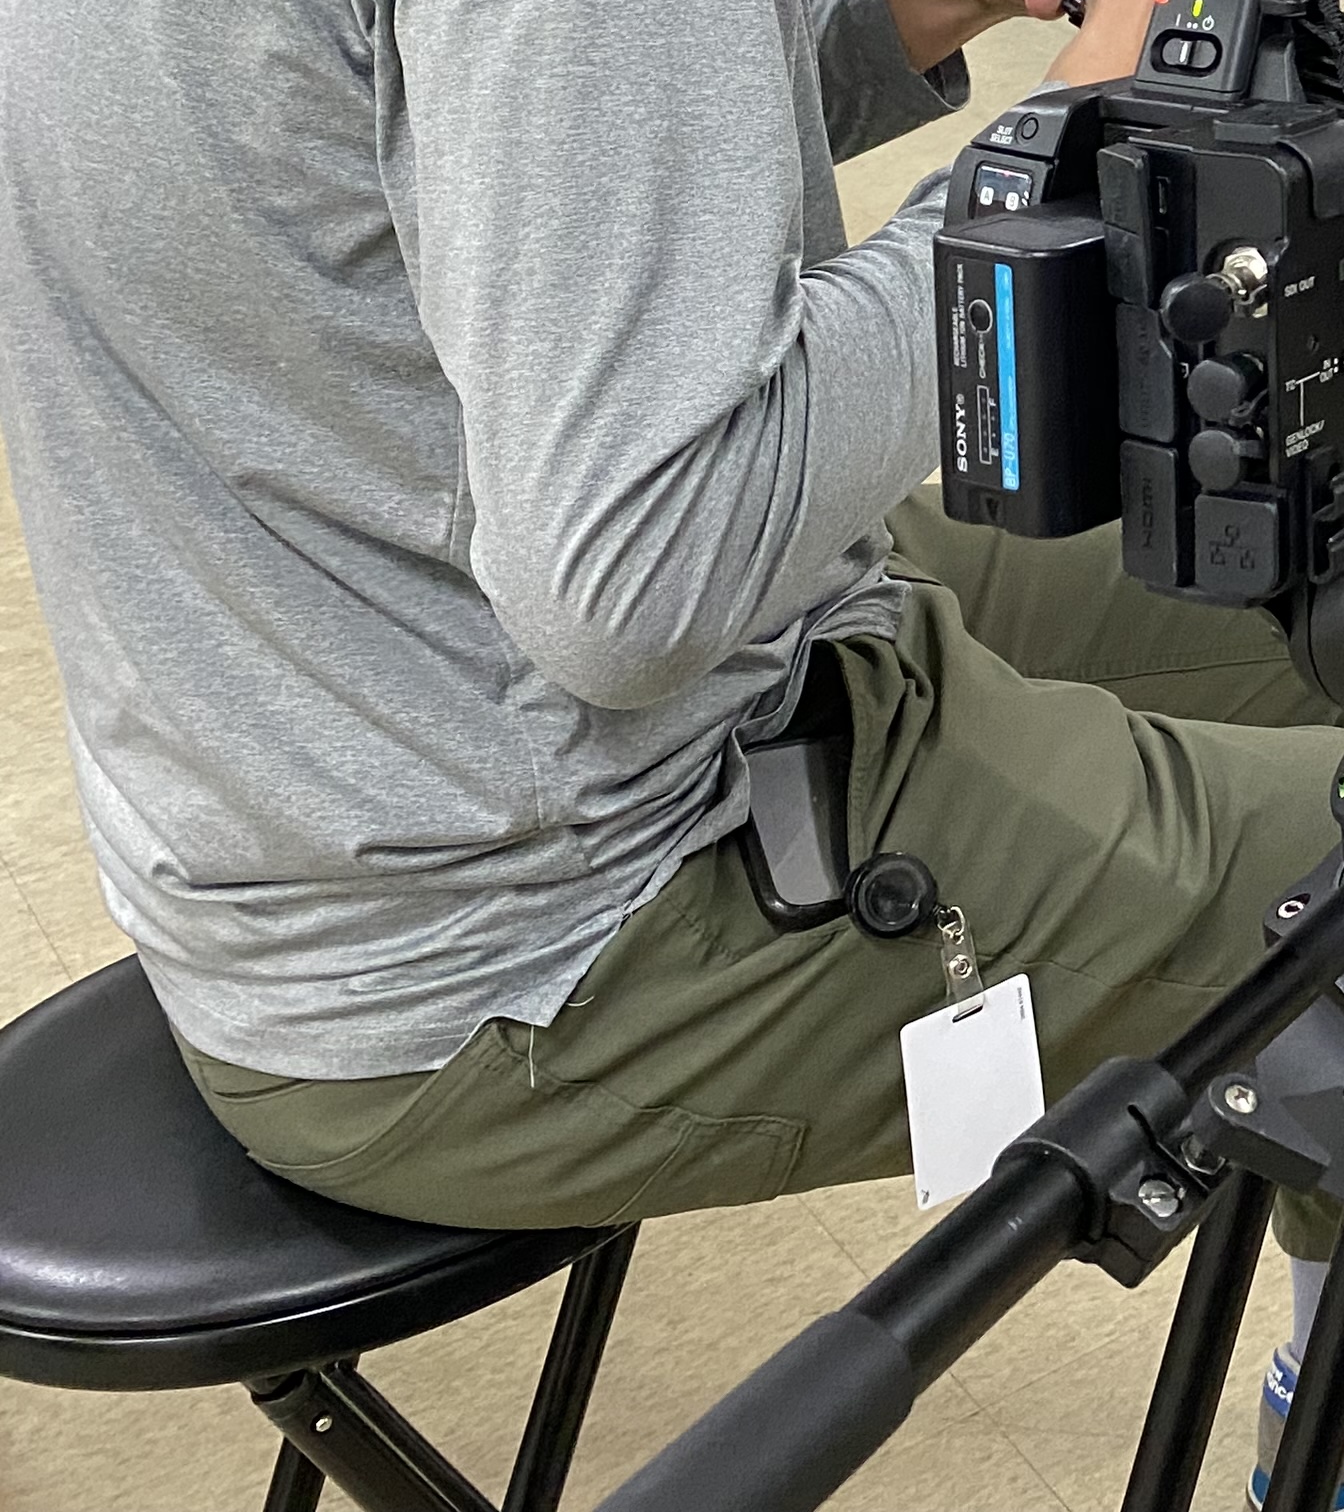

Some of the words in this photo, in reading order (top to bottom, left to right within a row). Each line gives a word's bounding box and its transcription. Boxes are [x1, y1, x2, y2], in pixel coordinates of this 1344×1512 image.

[996, 124, 1014, 136] SLOT
[989, 132, 1014, 145] SELECT
[955, 402, 968, 473] SONY
[1285, 438, 1309, 458] VIDEO
